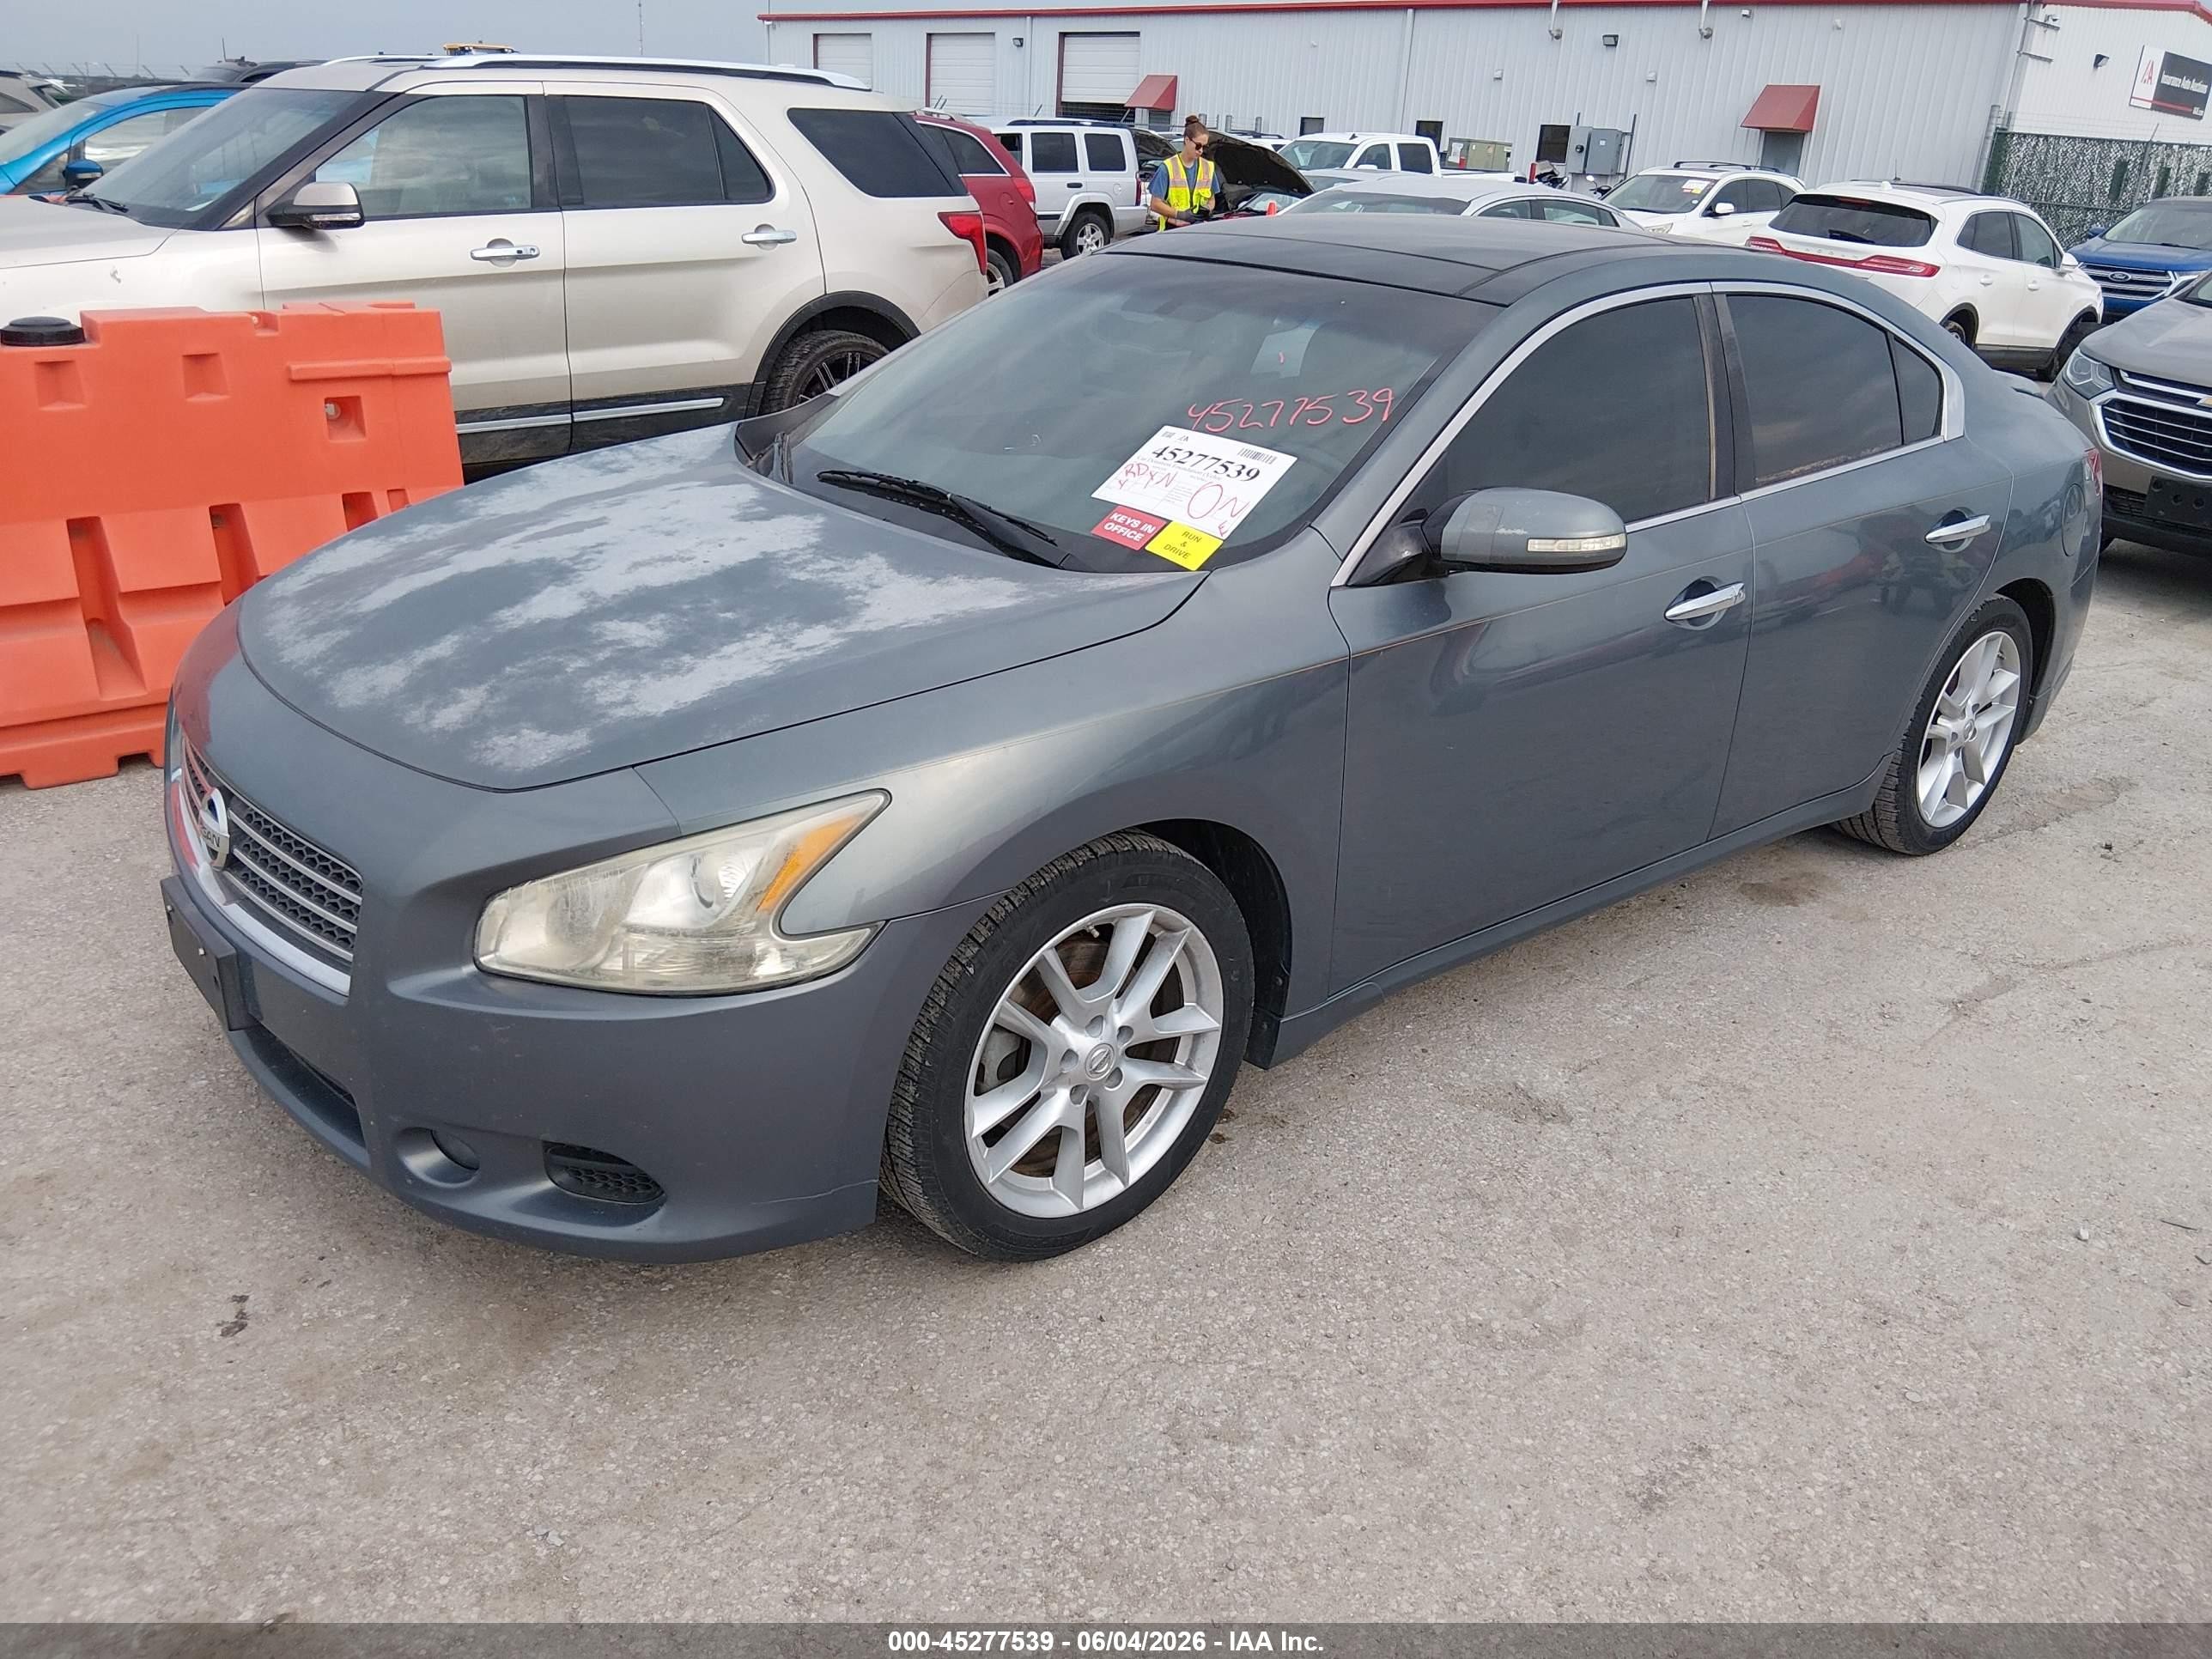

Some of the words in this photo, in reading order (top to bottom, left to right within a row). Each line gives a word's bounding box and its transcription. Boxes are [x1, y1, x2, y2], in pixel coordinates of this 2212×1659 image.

[1188, 387, 1395, 432] 45277539
[1152, 446, 1261, 482] 45277539
[1103, 521, 1145, 542] OFFICE
[1109, 513, 1140, 528] KEYS
[1140, 522, 1156, 534] IN
[1182, 531, 1202, 543] RUN
[1164, 544, 1190, 559] DRIVE
